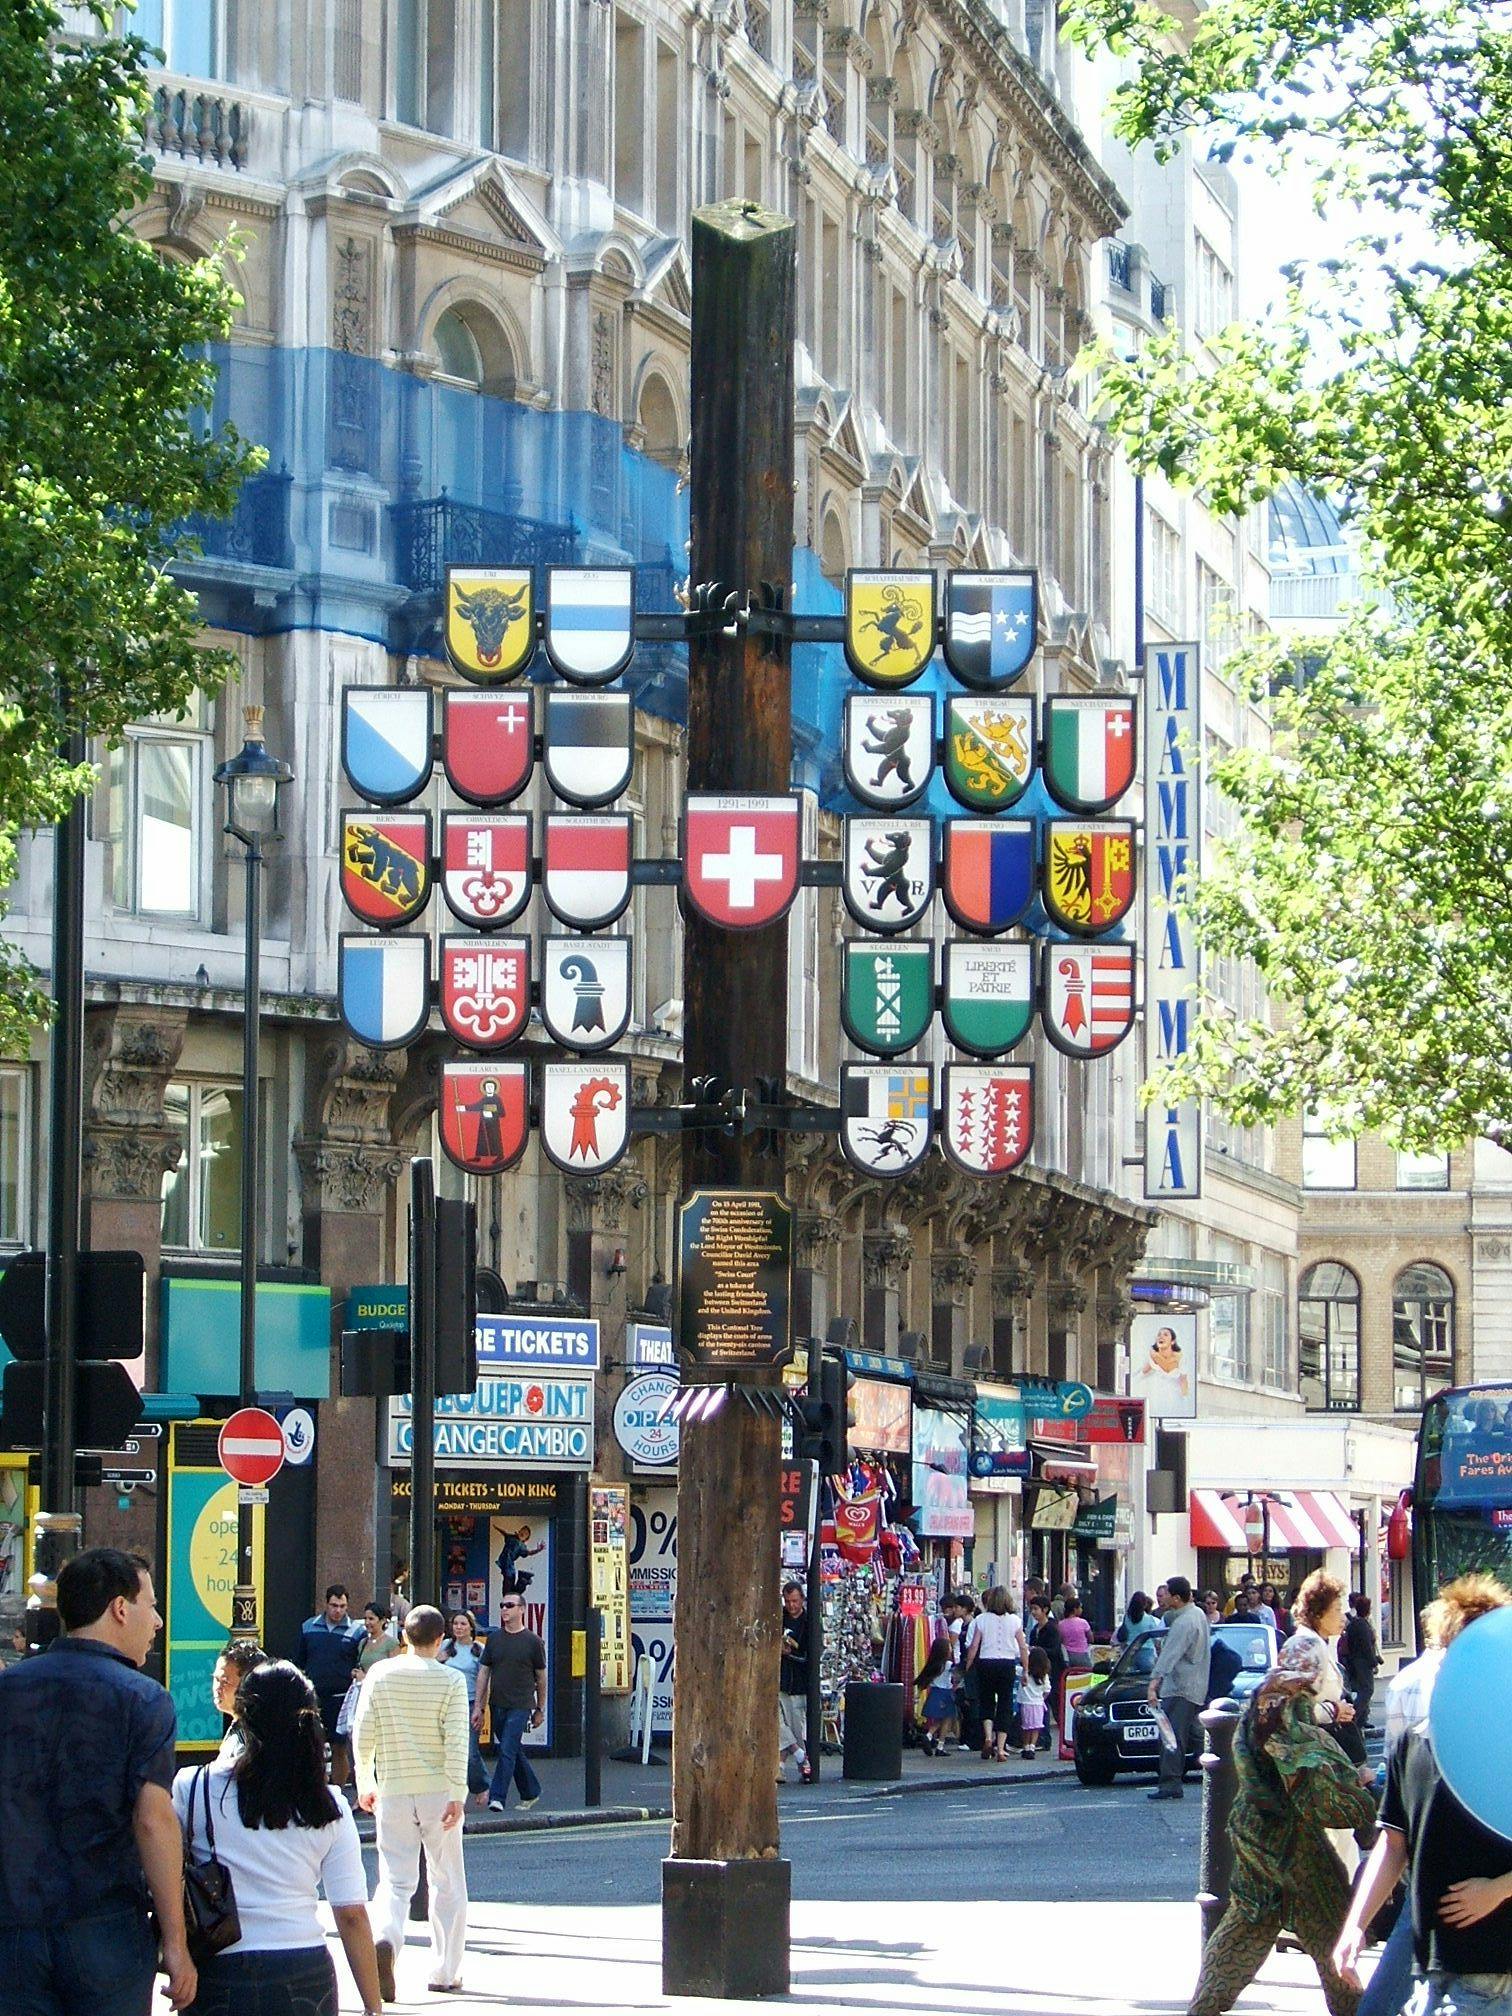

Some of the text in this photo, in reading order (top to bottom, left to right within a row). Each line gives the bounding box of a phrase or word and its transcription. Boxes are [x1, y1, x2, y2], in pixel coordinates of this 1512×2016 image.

[974, 699, 1010, 707] THURGAU
[1156, 652, 1190, 969] MAMMA
[375, 815, 396, 823] BERN
[466, 816, 509, 824] OBWALDEN
[565, 817, 611, 825] SOLOTHURN
[861, 880, 875, 895] V
[912, 881, 925, 896] R
[369, 939, 399, 947] LUZERN
[463, 939, 508, 948] NIDWALDEN
[965, 960, 1016, 973] LIBERTÉ
[982, 972, 998, 982] ET
[969, 982, 1012, 994] PATRIE
[469, 1065, 499, 1073] GLARUS
[712, 1200, 721, 1208] On
[729, 1218, 764, 1226] anniversary
[734, 1235, 768, 1243] Worshipful
[714, 1290, 735, 1298] lasting
[736, 1291, 768, 1299] friendship
[697, 1332, 722, 1340] displays
[502, 1329, 590, 1356] TICKETS
[400, 1423, 499, 1454] CANGE
[649, 1428, 662, 1439] 24
[633, 1440, 678, 1456] HOURS
[1467, 1453, 1490, 1465] The
[1460, 1464, 1494, 1477] Fares
[443, 1482, 488, 1496] TICKETS
[498, 1483, 526, 1497] LION
[528, 1483, 557, 1498] KING
[438, 1502, 500, 1510] MONDAY THURSDAY
[903, 1588, 924, 1605] £3.99
